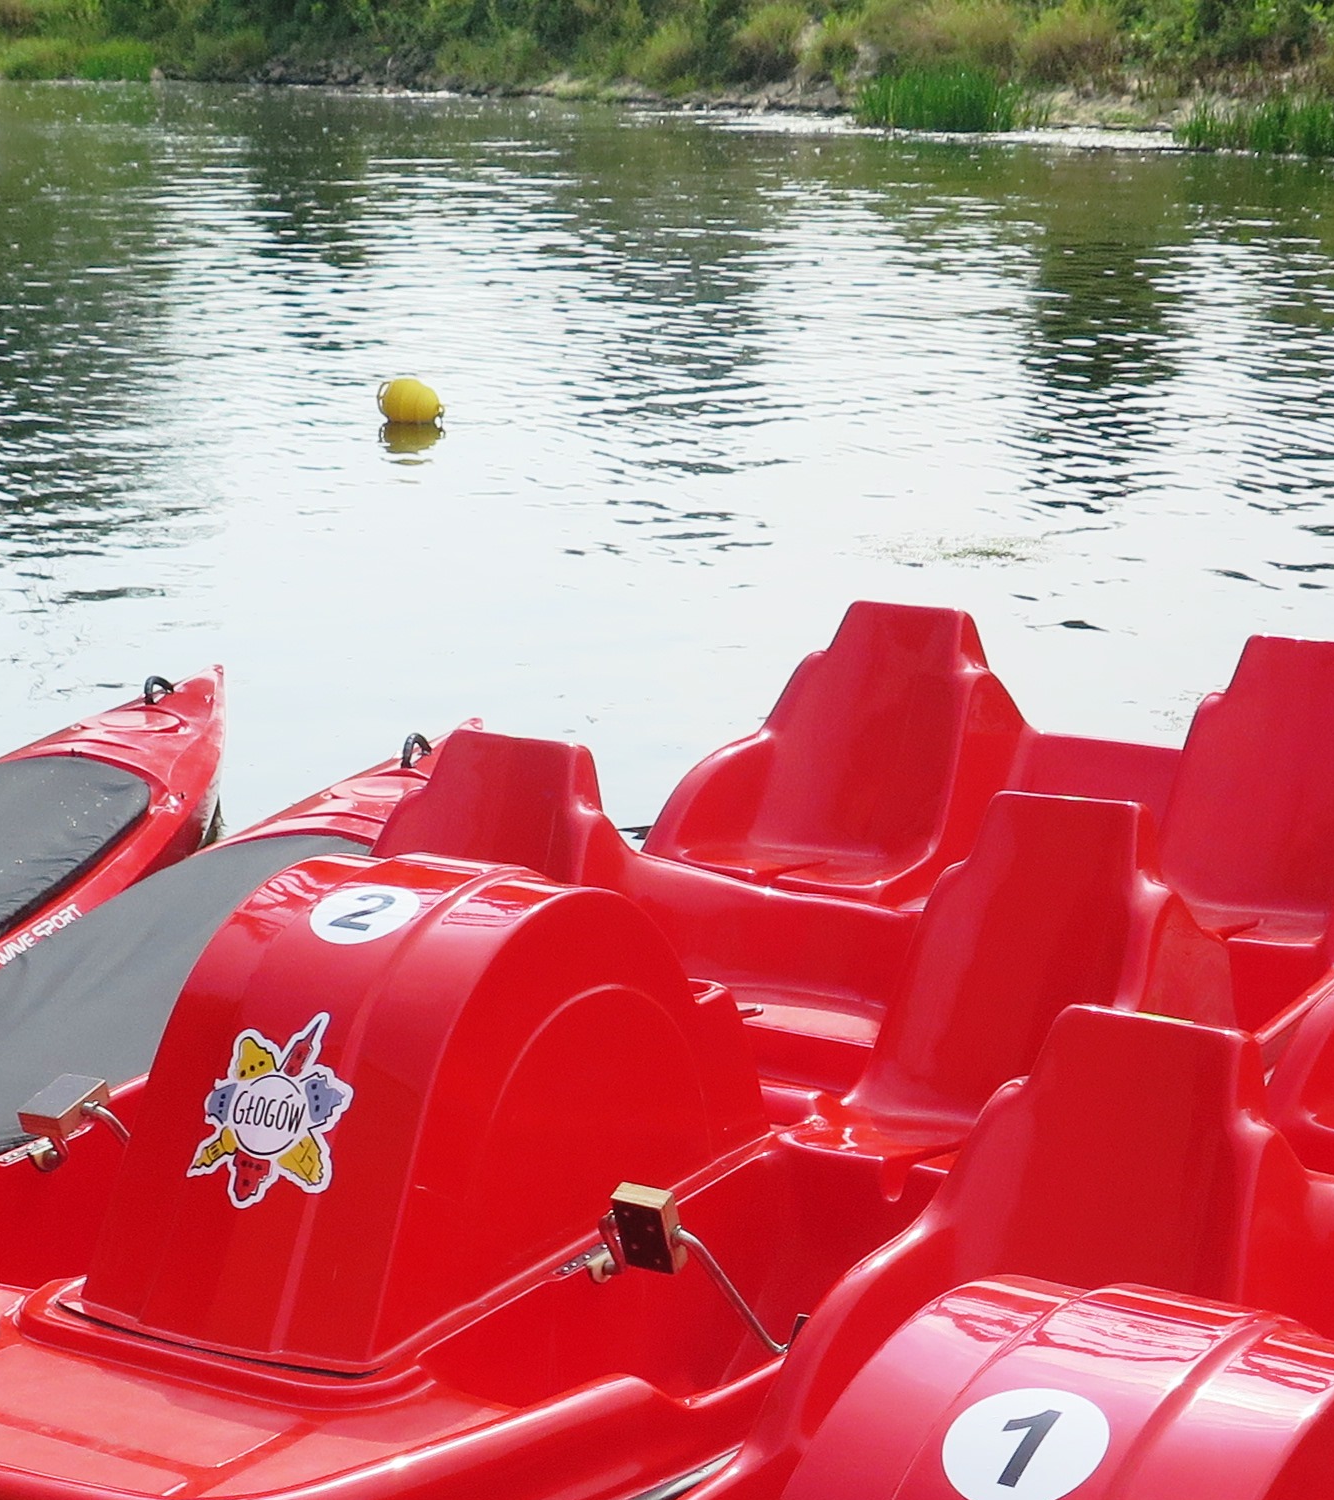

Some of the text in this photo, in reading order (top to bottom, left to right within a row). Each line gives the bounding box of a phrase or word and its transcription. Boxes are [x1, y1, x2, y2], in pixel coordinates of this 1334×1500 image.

[31, 903, 84, 937] SPORT
[329, 893, 397, 932] 2
[232, 1090, 307, 1135] GŁOGÓW
[996, 1408, 1064, 1489] 1
